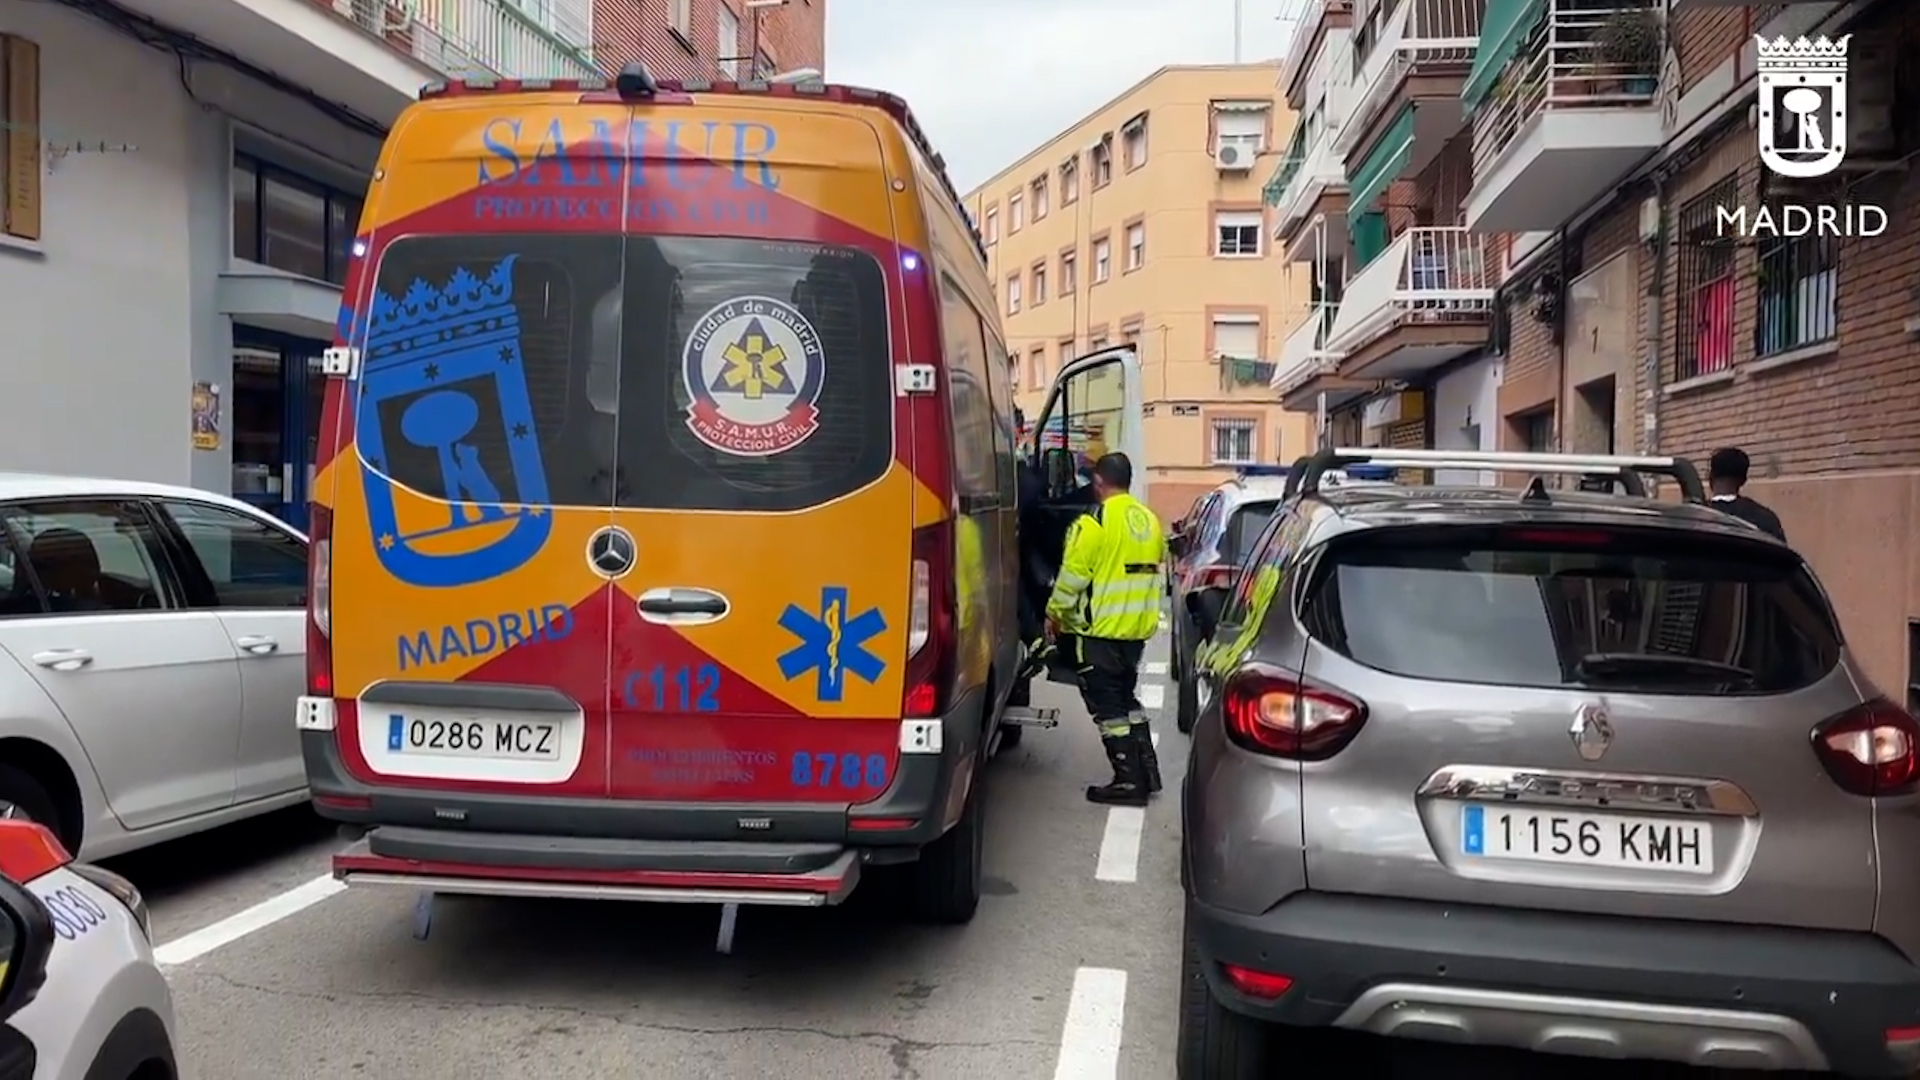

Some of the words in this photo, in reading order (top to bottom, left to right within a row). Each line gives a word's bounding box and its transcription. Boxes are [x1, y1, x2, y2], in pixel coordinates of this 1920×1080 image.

[479, 116, 781, 193] SAMUR
[692, 304, 736, 352] ciudad
[743, 300, 764, 313] de
[771, 306, 819, 356] madrid
[697, 420, 775, 450] PROTECCION
[778, 423, 810, 444] CIVIL
[397, 603, 575, 672] MADRID
[650, 662, 721, 712] 112
[410, 719, 484, 750] 0286
[496, 723, 554, 754] MCZ
[791, 751, 887, 788] 8788
[1500, 814, 1602, 857] 1156
[1619, 822, 1701, 866] KMH
